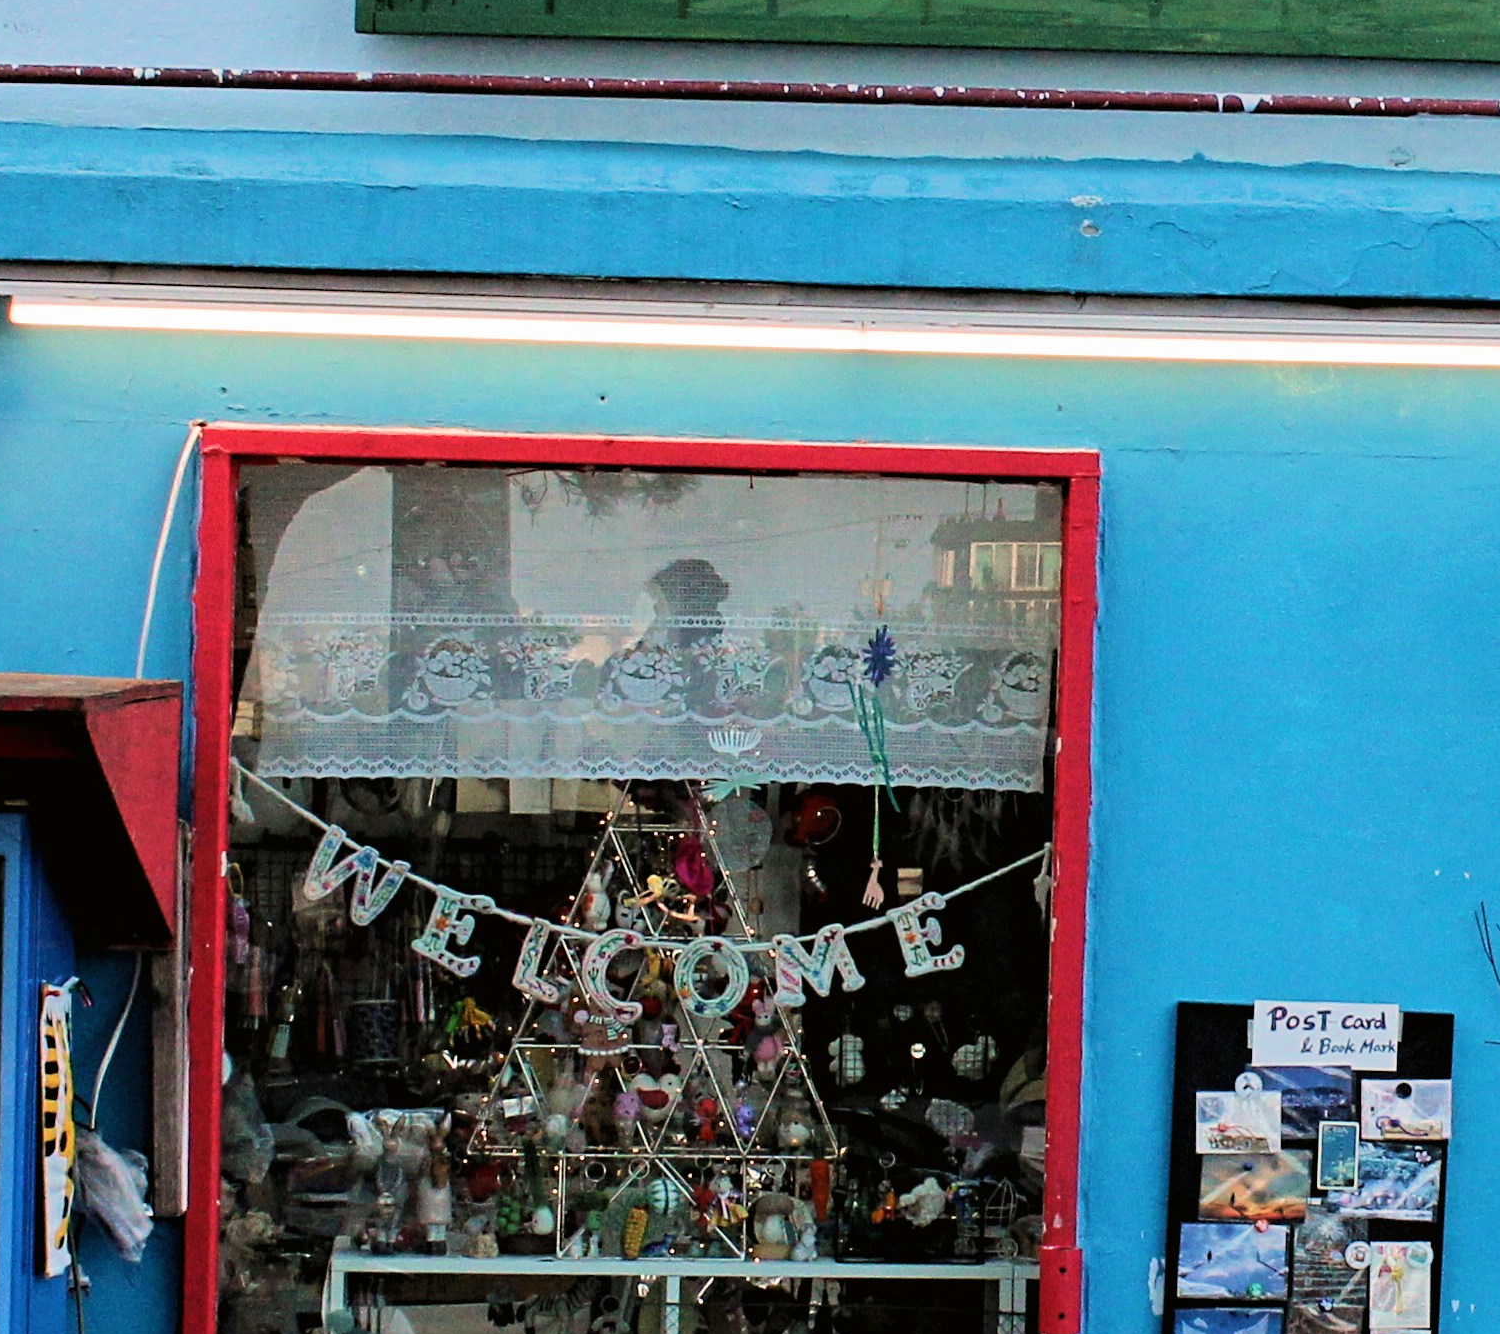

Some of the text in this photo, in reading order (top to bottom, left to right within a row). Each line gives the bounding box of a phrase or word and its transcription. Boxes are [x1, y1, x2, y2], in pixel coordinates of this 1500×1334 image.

[303, 823, 966, 1022] WELCOME
[1319, 1037, 1355, 1055] Book
[1360, 1038, 1396, 1054] Mark
